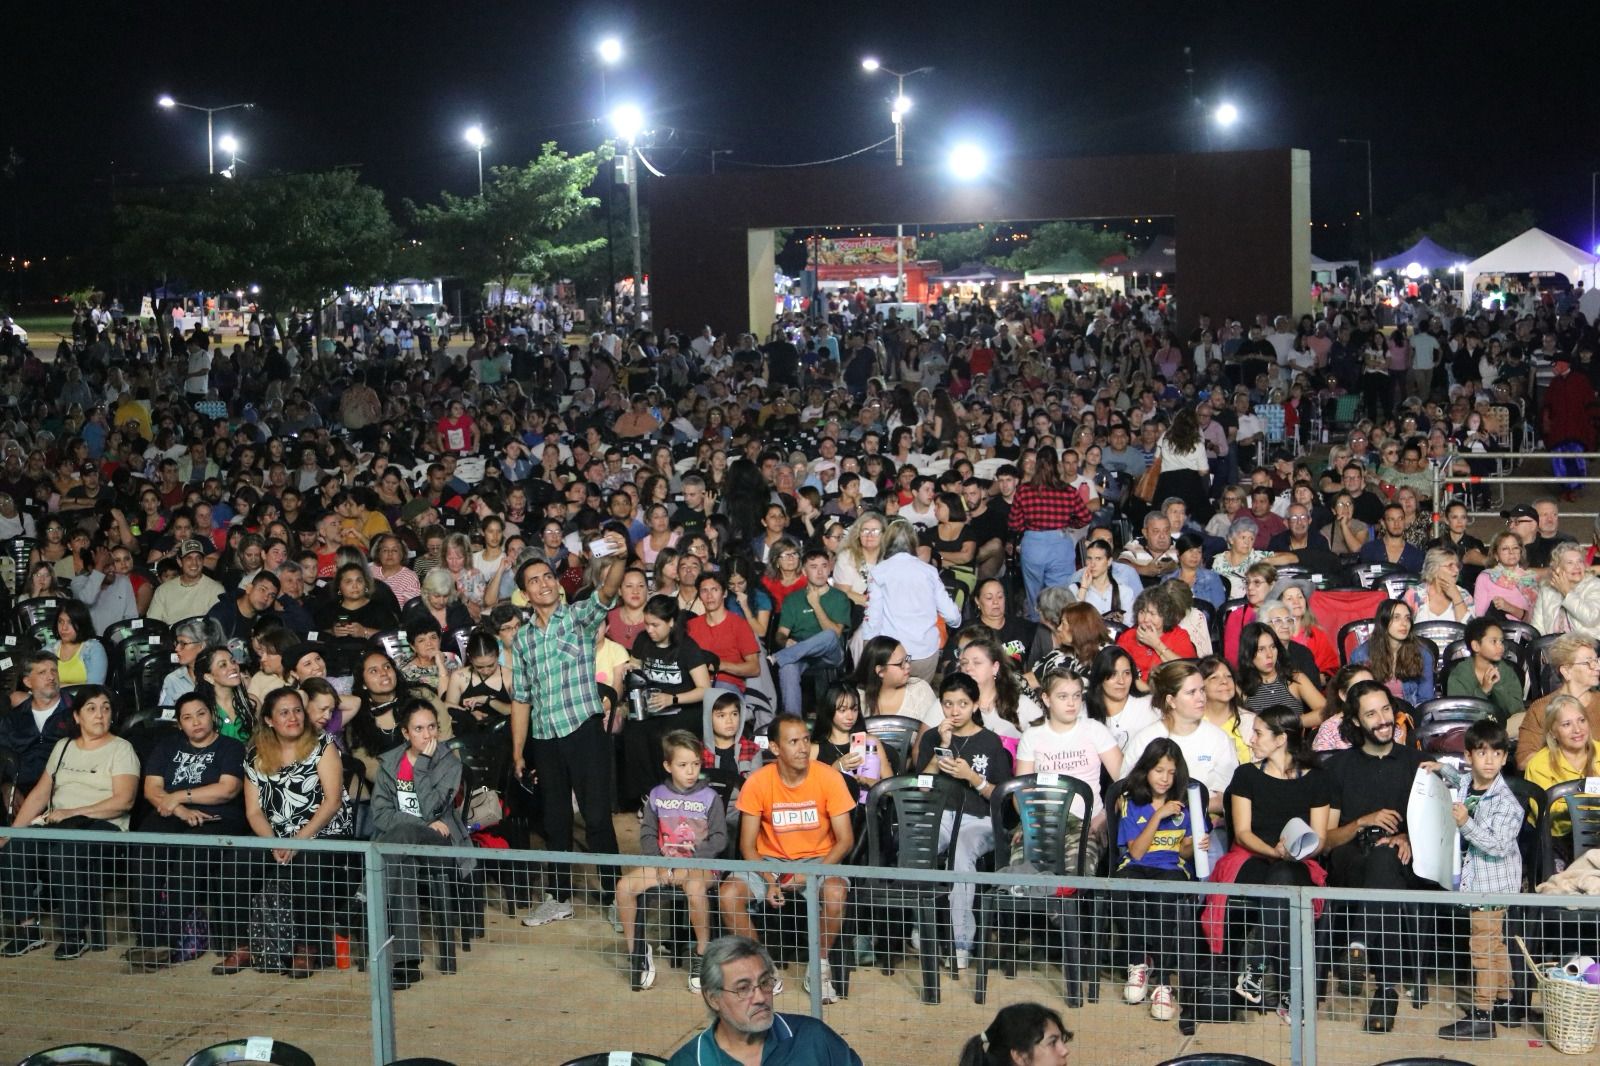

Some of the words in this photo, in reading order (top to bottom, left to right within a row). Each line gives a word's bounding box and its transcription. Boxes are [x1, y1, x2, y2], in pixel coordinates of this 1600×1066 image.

[1043, 749, 1086, 761] Nothing
[1038, 763, 1049, 771] to
[1053, 758, 1088, 771] Regret
